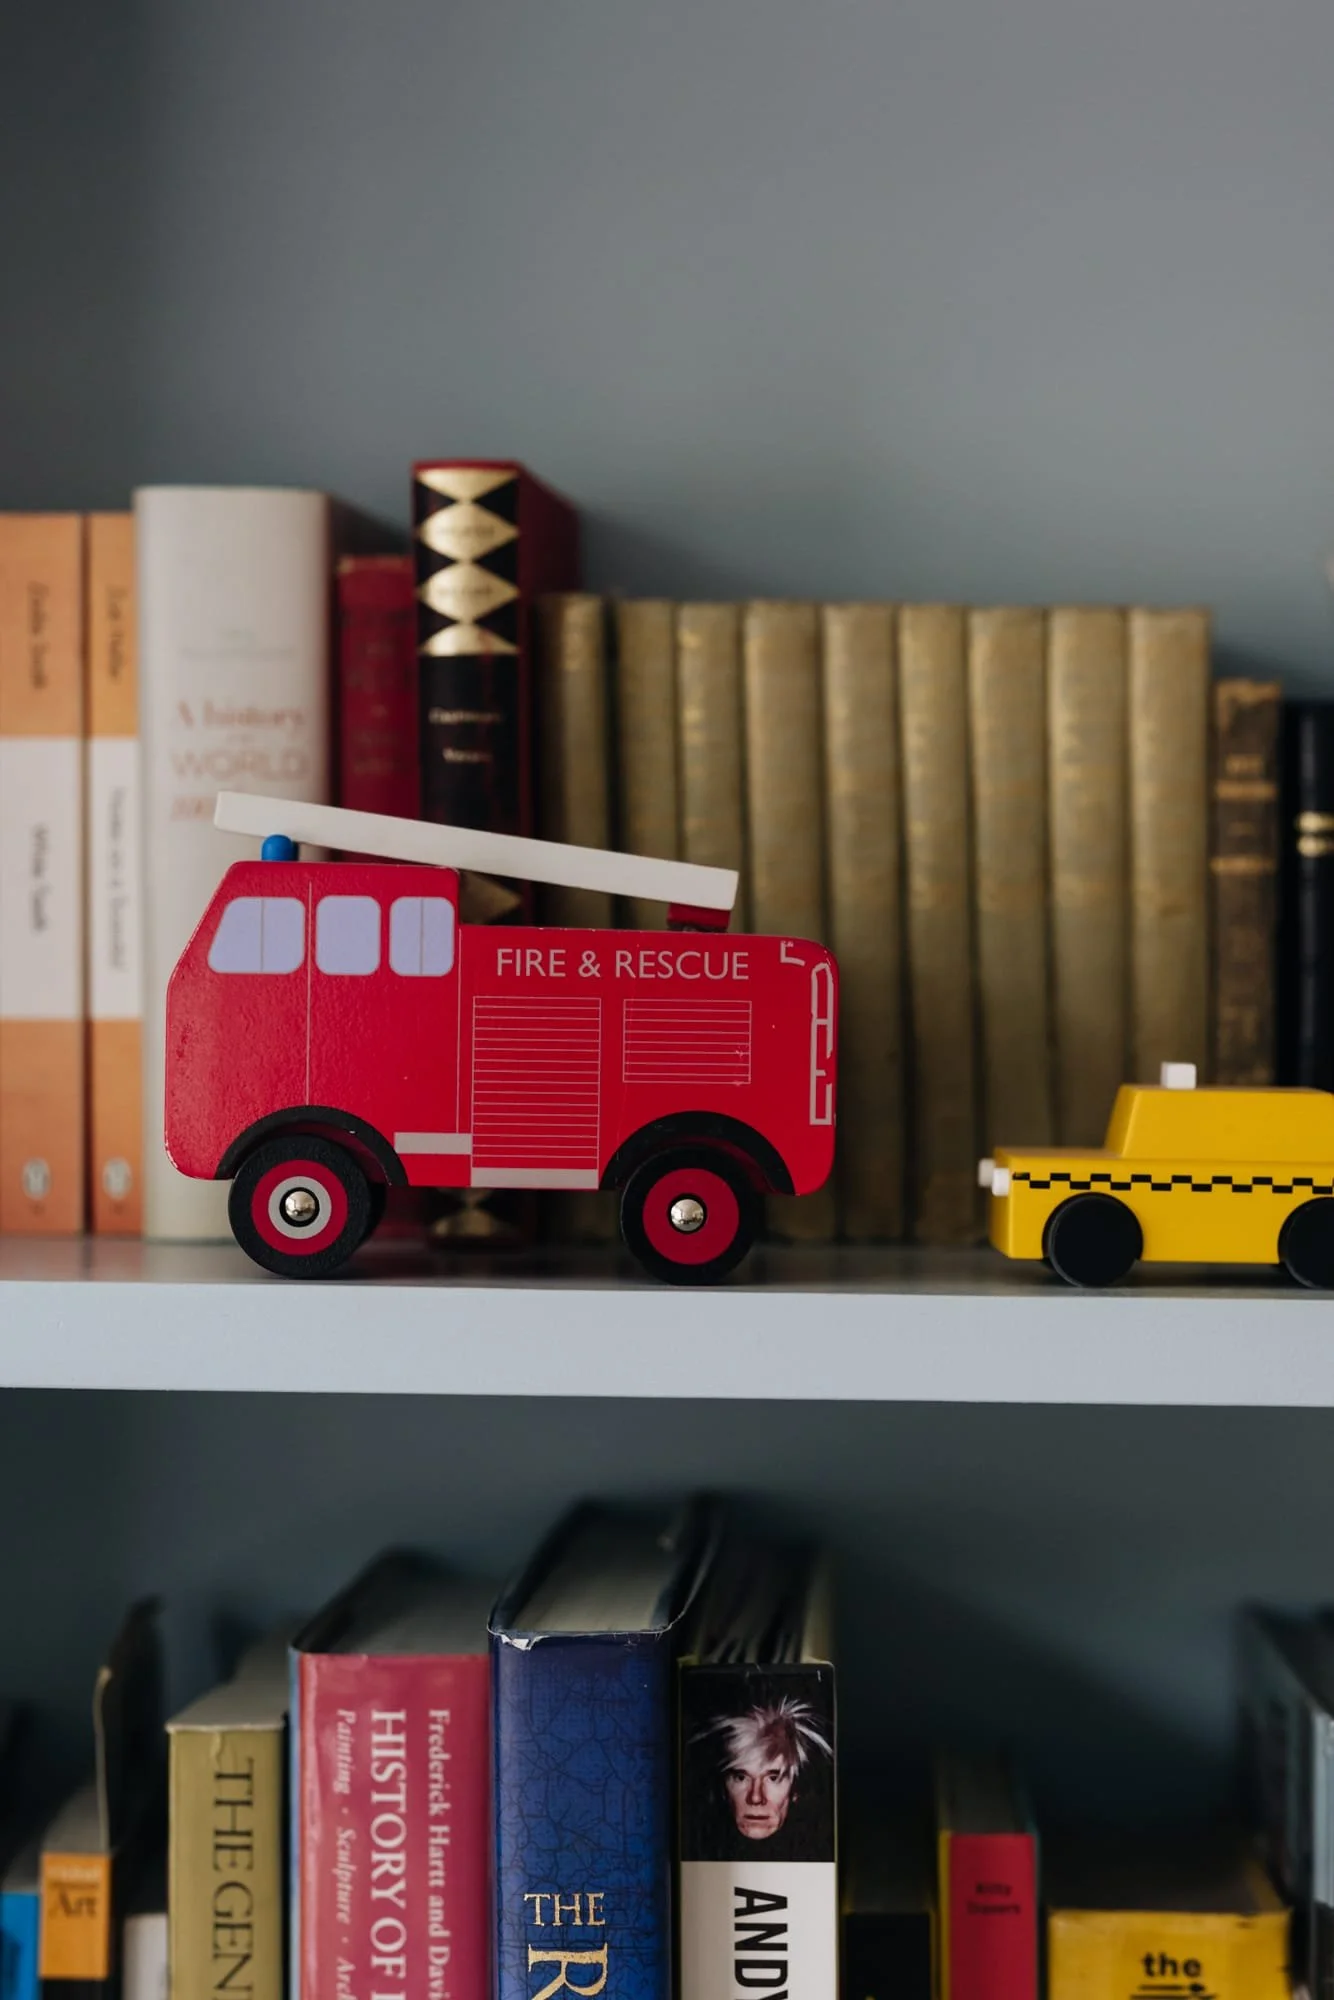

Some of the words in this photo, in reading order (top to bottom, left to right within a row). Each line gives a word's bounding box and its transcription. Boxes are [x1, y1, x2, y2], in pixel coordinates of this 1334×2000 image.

[170, 748, 311, 781] WORLD
[496, 947, 566, 978] FIRE
[578, 949, 601, 978] &
[615, 950, 750, 981] RESCUE
[334, 1709, 356, 1794] Painting
[428, 1709, 450, 1816] Frederick
[213, 1757, 254, 1872] THE
[371, 1709, 407, 1909] HISTORY
[332, 1827, 357, 1924] Sculpture
[428, 1825, 450, 1886] Hartt
[428, 1895, 451, 1938] and
[523, 1892, 606, 1927] THE
[213, 1881, 254, 2000] GEN
[371, 1917, 407, 1978] OF
[1142, 1951, 1202, 1977] the
[428, 1946, 450, 2000] Davi
